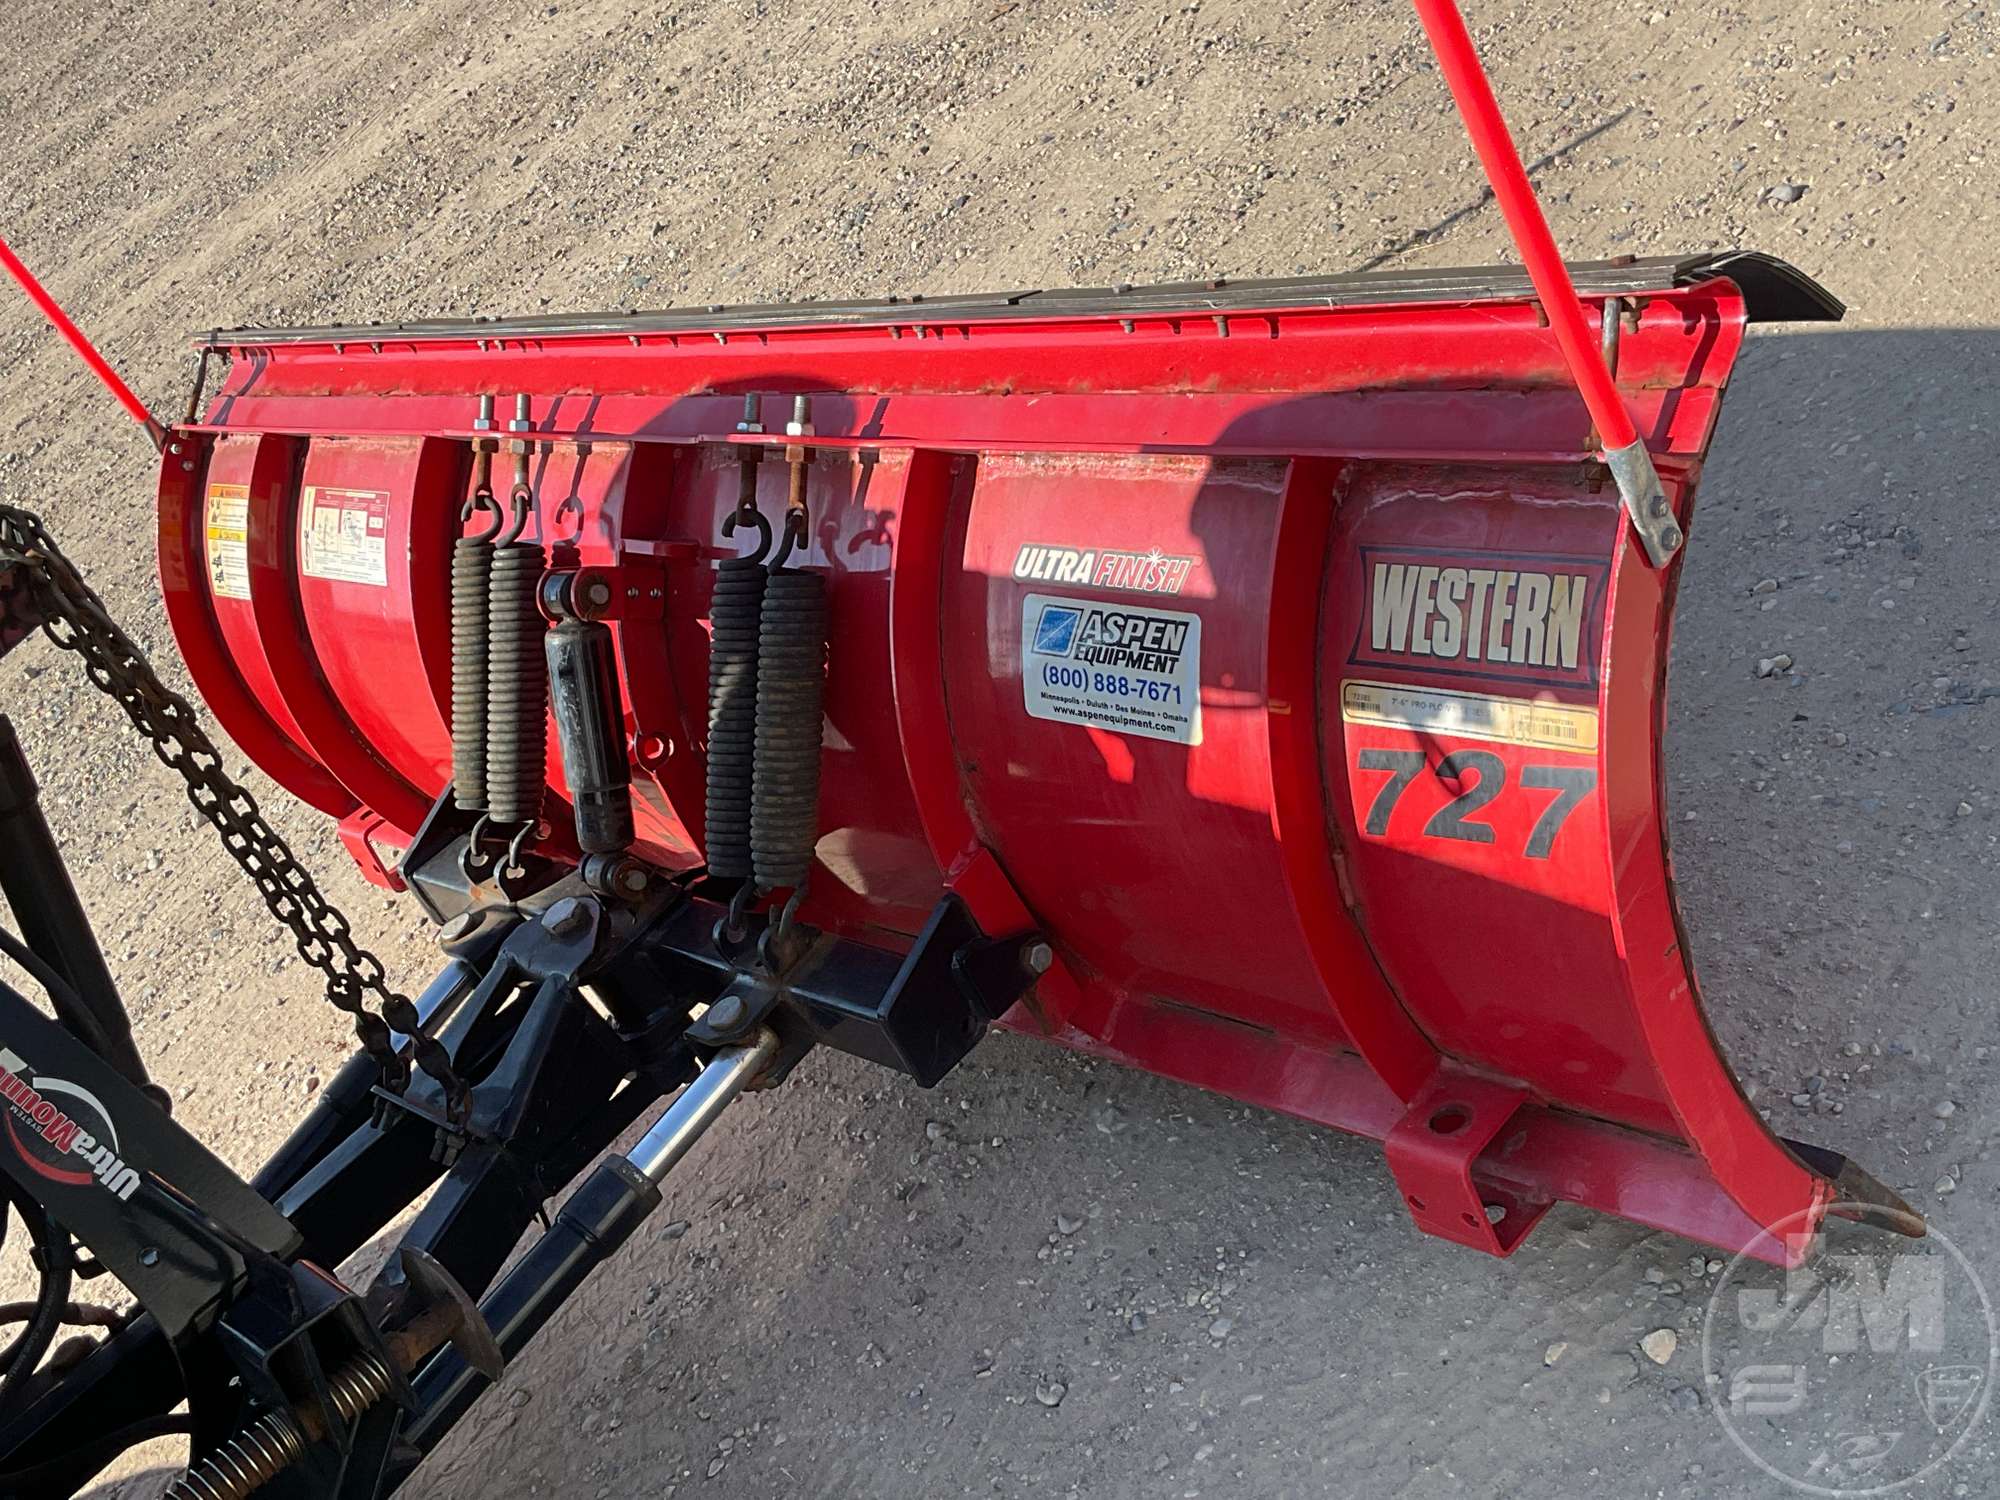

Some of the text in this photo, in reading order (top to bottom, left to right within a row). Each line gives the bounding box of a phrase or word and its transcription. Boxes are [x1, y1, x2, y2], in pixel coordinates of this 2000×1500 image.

[1014, 547, 1190, 593] ULTRA FINISH
[1078, 610, 1190, 656] ASPEN
[1371, 562, 1588, 672] WESTERN
[1074, 643, 1180, 674] EQUIPMENT
[1043, 663, 1182, 705] (800) 888-7671
[1040, 691, 1188, 723] Minneapolis Duluth Des Moines Omaha
[1053, 705, 1175, 734] www.aspenequipment.com
[1357, 749, 1598, 860] 727
[10, 1104, 43, 1133] SYSTEM
